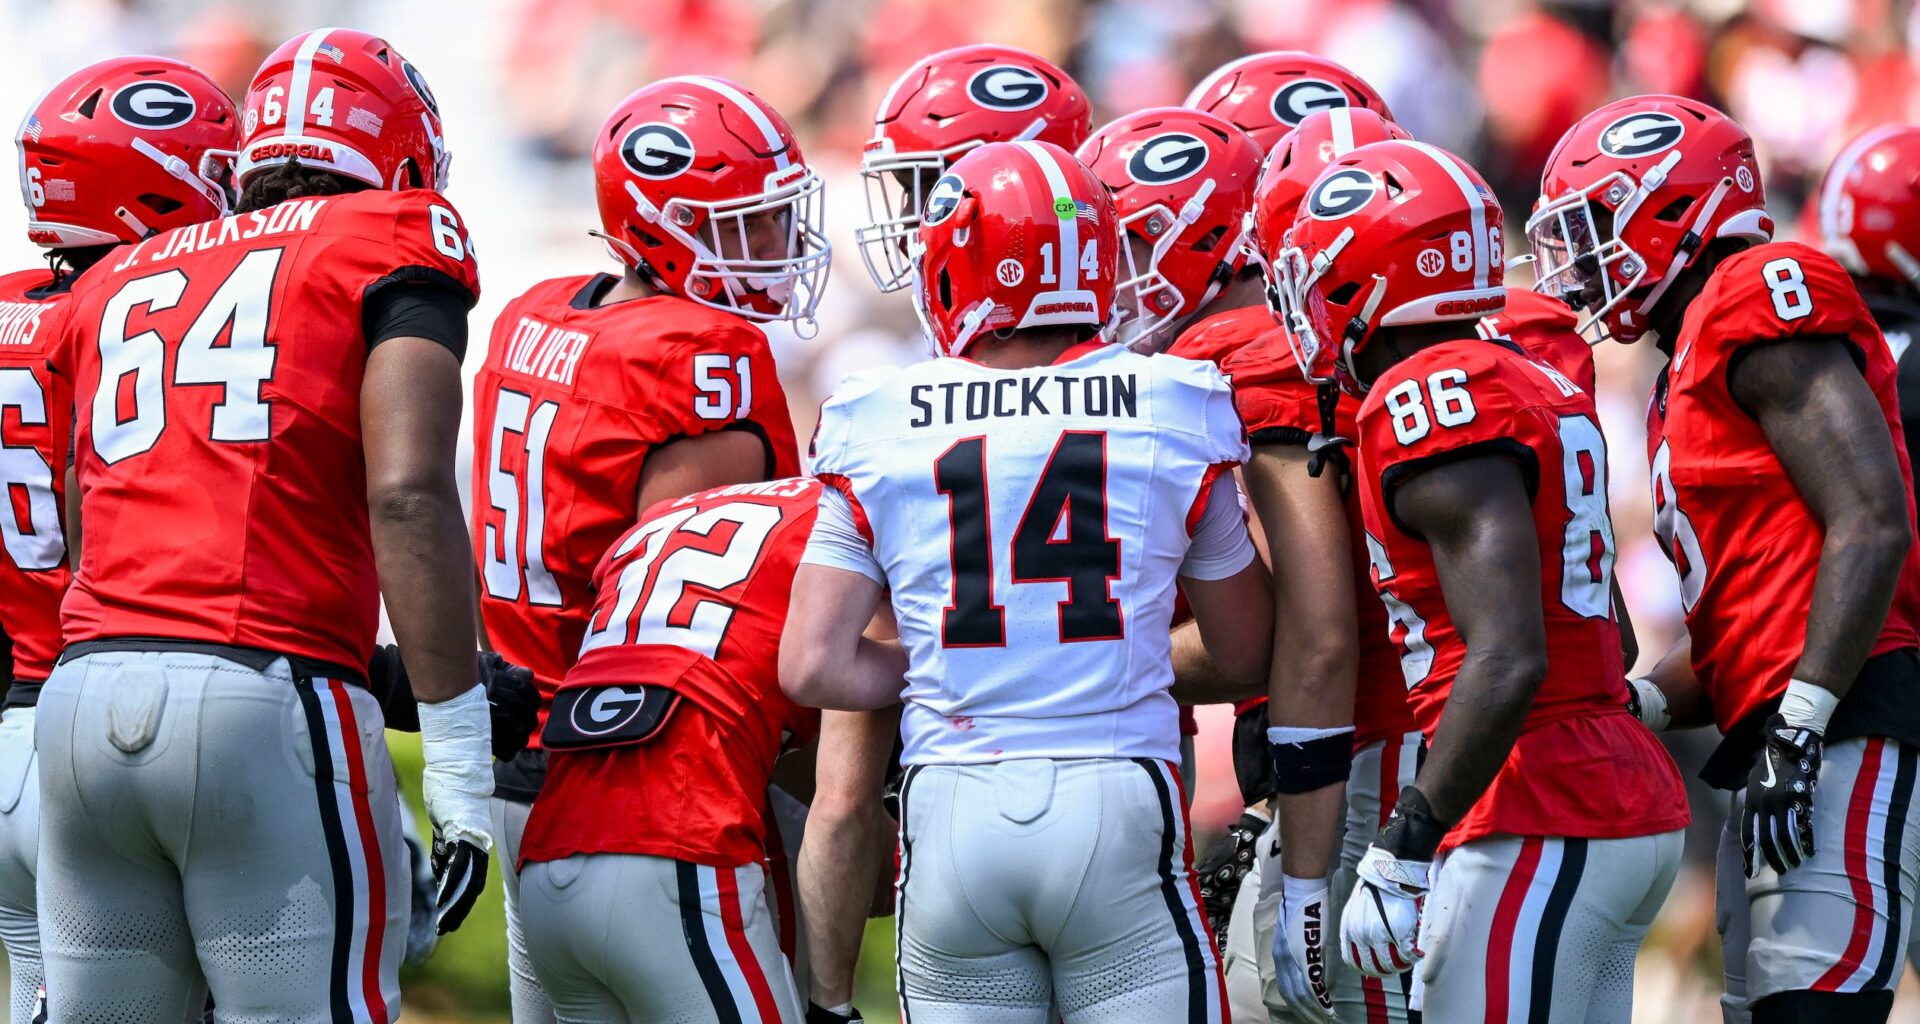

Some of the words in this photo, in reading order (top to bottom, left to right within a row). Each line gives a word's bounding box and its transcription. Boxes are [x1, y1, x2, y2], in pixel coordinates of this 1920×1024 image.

[112, 83, 194, 126] G
[970, 67, 1046, 108] G
[1273, 81, 1349, 124] G
[250, 143, 335, 163] GEORGIA
[622, 124, 692, 176] G
[1129, 133, 1208, 183] G
[1600, 113, 1683, 157] G
[27, 167, 46, 207] 6
[925, 175, 964, 224] G
[1055, 203, 1074, 213] C2P
[1310, 170, 1375, 219] G
[113, 237, 149, 272] J.
[152, 200, 327, 261] JACKSON
[1001, 264, 1021, 283] SEC
[1419, 253, 1442, 274] SEC
[1034, 302, 1094, 315] GEORGIA
[1762, 257, 1814, 322] 8
[90, 246, 286, 468] 64
[504, 316, 590, 386] TOLIVER
[693, 353, 752, 420] 51
[910, 373, 1137, 428] STOCKTON
[1384, 368, 1477, 446] 86
[0, 366, 68, 572] 6
[705, 476, 819, 500] JONES
[484, 386, 564, 608] 51
[1557, 412, 1617, 621] 8
[933, 429, 1124, 649] 14
[1651, 435, 1709, 616] 8
[578, 501, 784, 660] 32
[572, 685, 643, 734] G
[1303, 900, 1333, 1009] GEORGIA
